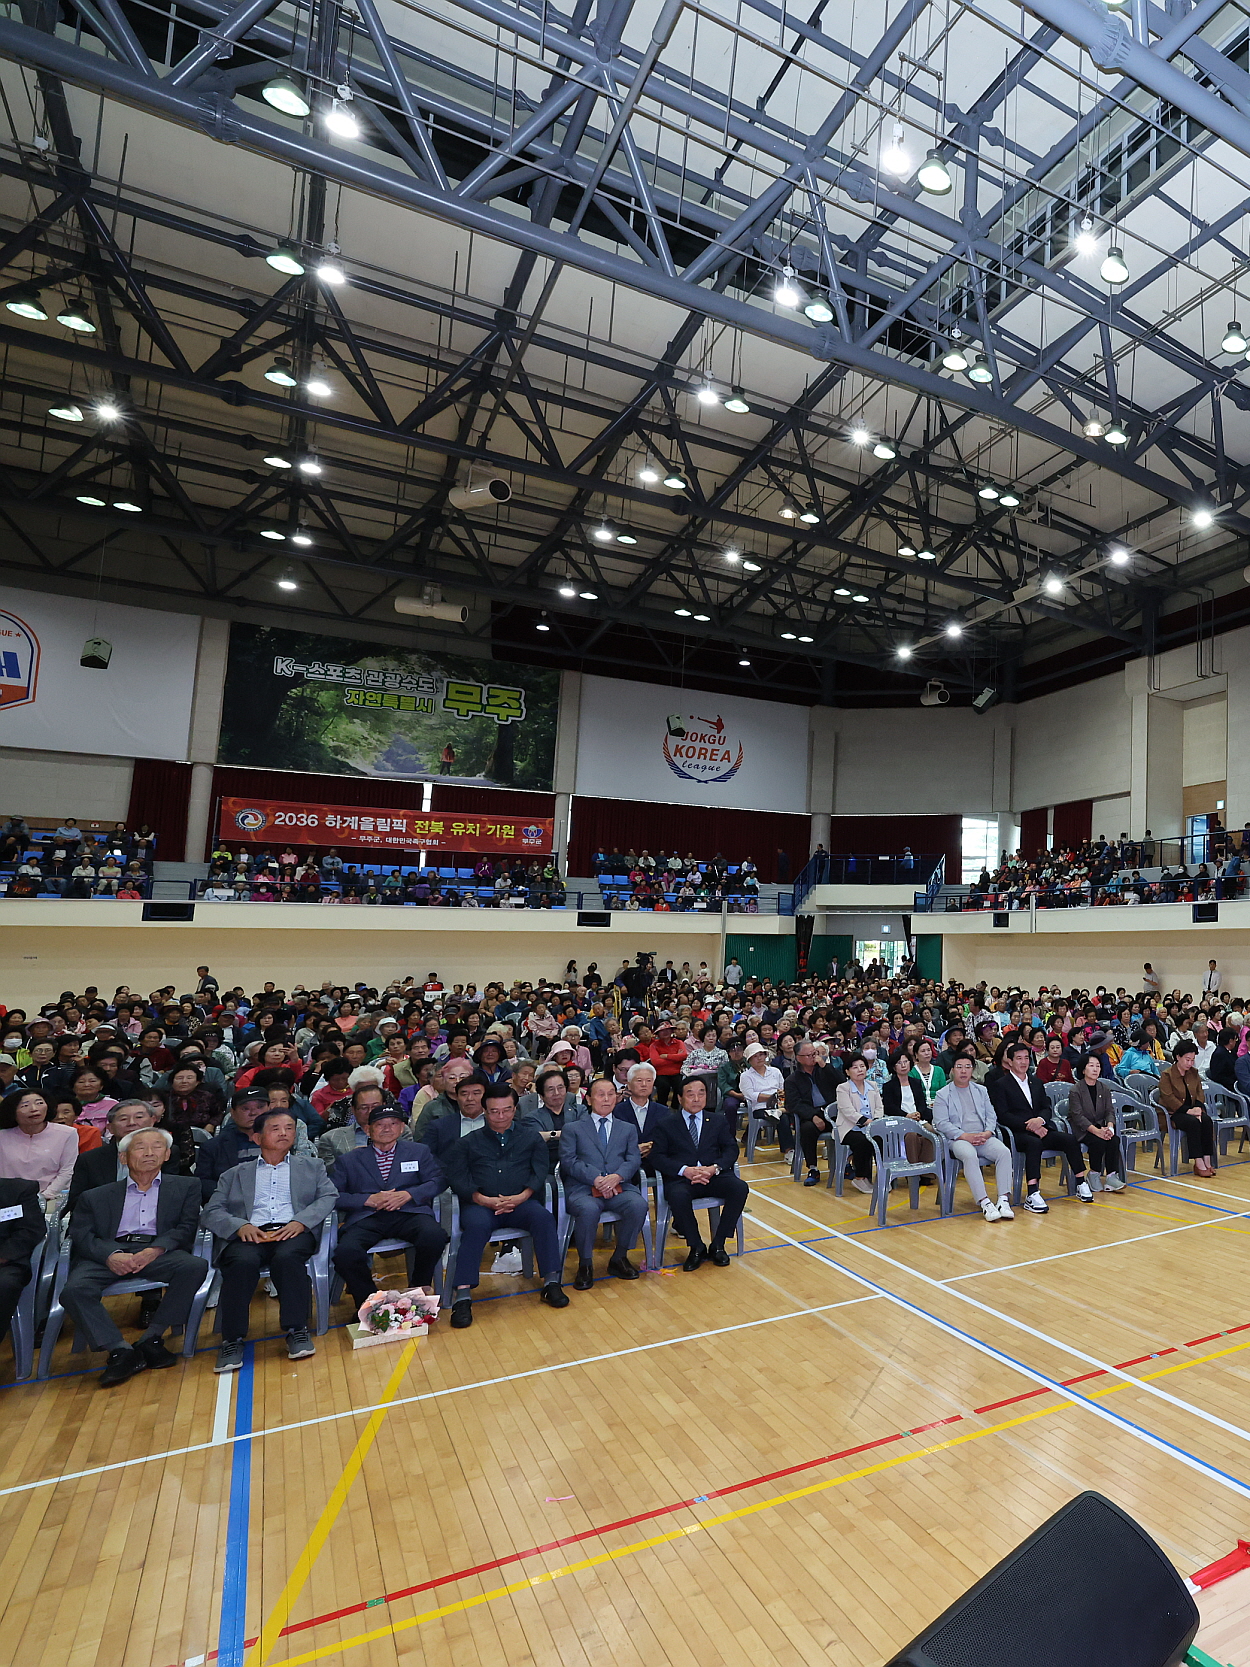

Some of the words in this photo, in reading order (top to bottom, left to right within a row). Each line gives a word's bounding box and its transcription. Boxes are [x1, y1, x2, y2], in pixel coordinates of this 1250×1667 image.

[274, 656, 363, 685] K-스포츠
[365, 669, 436, 694] 관광수도
[345, 688, 434, 714] 자연특별시
[443, 677, 526, 724] 무주
[681, 731, 726, 745] JOKGU
[673, 744, 731, 763] KOREA
[682, 760, 721, 773] league
[274, 812, 319, 827] 2036
[325, 814, 407, 833] 하계올림픽
[414, 820, 444, 835] 전북
[450, 822, 480, 837] 유치
[487, 824, 515, 839] 기원
